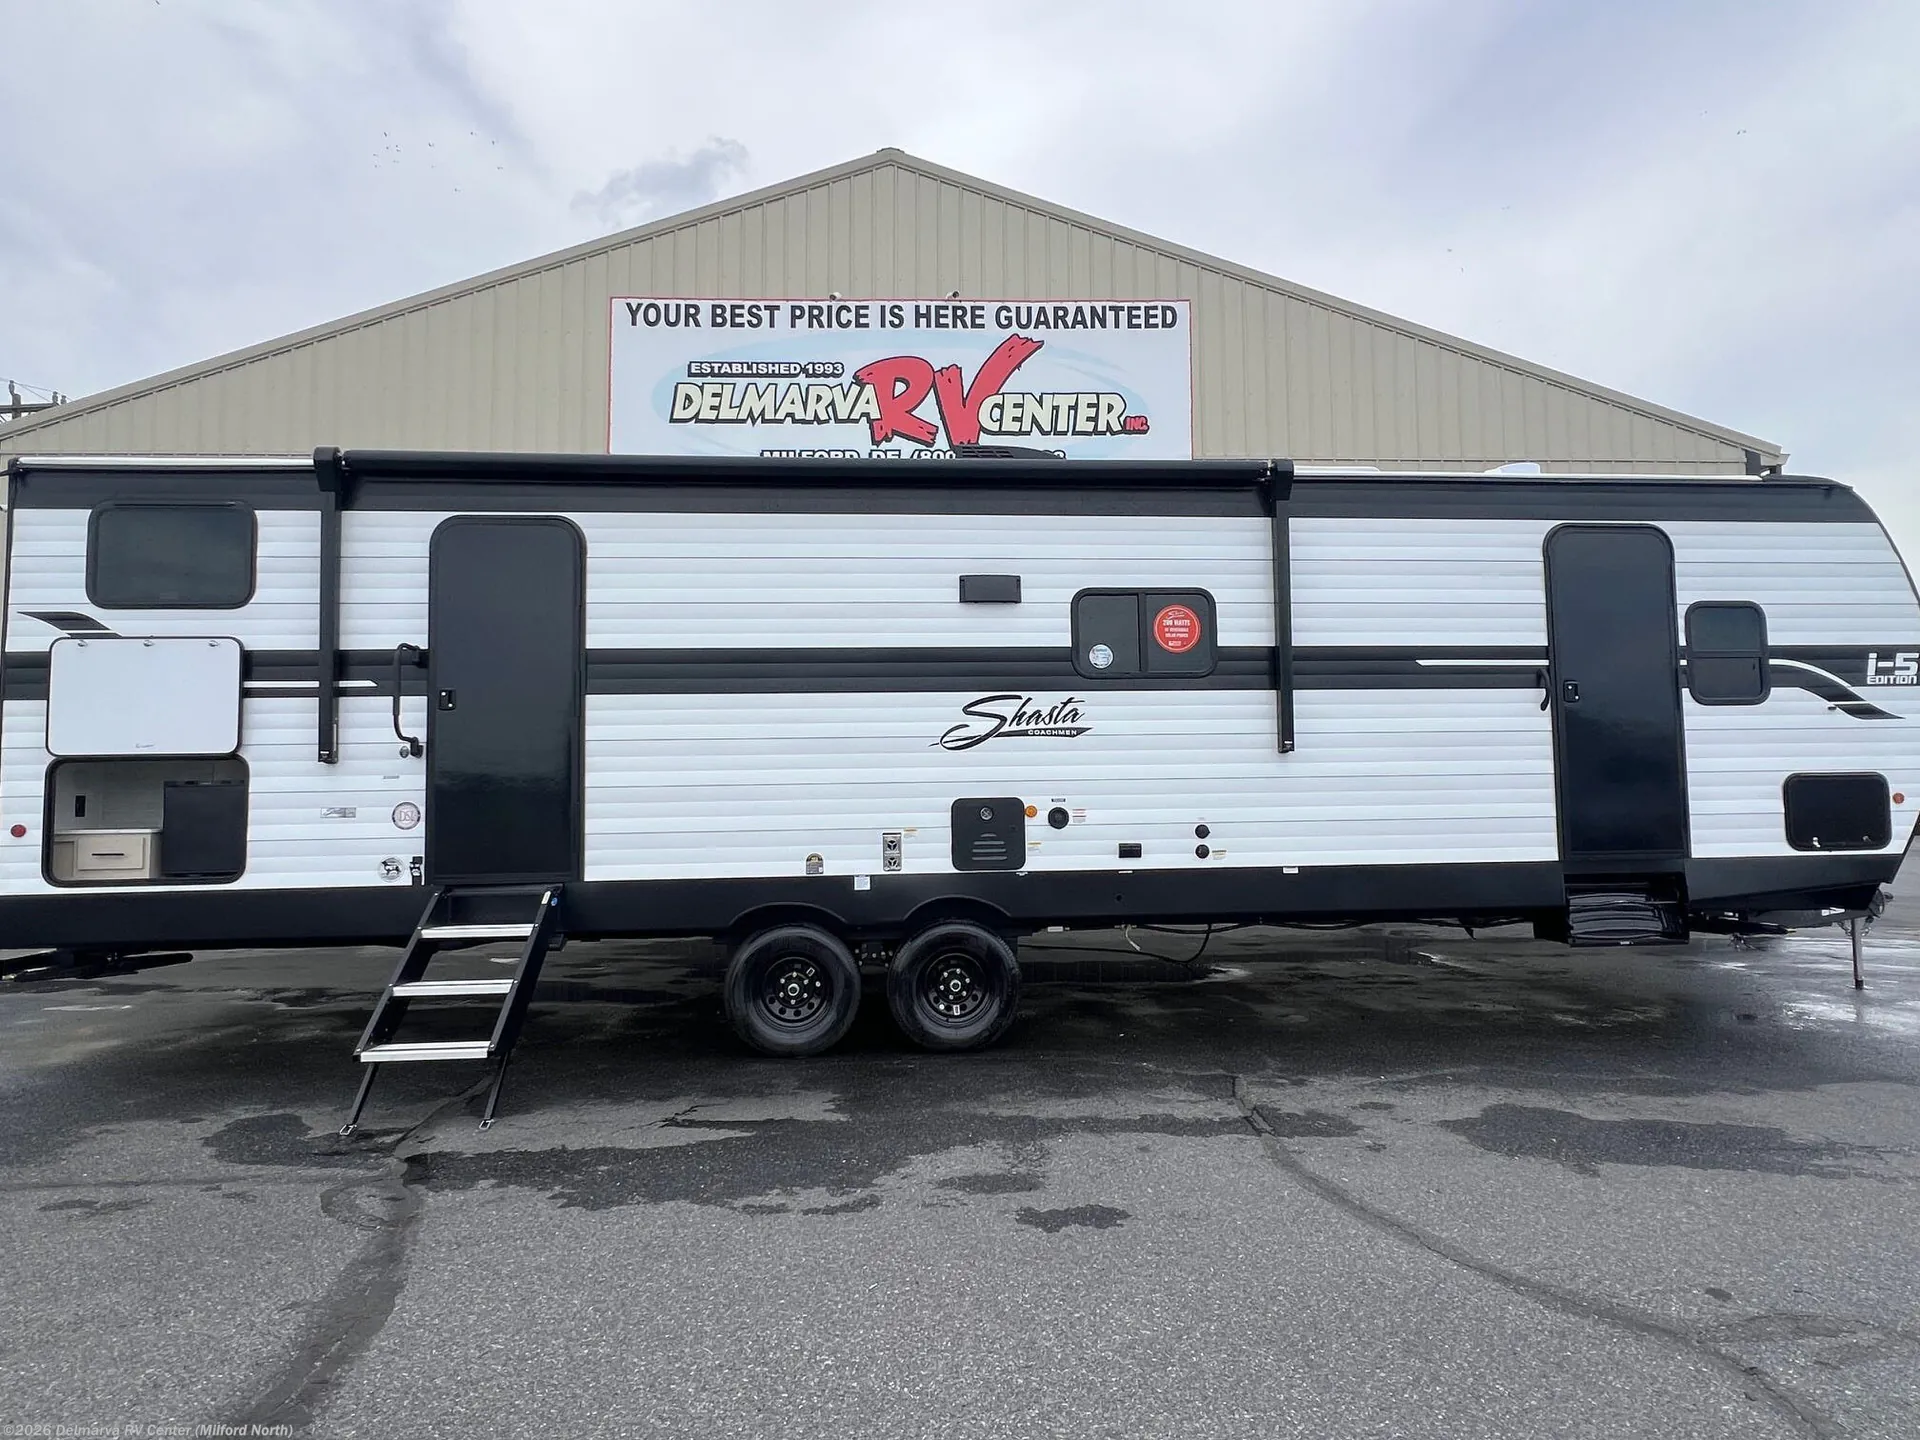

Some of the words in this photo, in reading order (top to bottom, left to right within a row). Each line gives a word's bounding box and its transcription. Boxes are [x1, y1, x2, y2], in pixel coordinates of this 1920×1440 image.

[625, 302, 701, 328] YOUR
[710, 304, 781, 329] BEST
[789, 304, 870, 329] PRICE
[879, 304, 905, 328] IS
[913, 305, 986, 329] HERE
[994, 305, 1178, 330] GUARANTEED
[688, 361, 801, 377] ESTABLISHED
[803, 363, 845, 375] 1993
[669, 382, 883, 426] DELMARVA
[853, 333, 1045, 446] RV
[976, 392, 1126, 436] CENTER
[1867, 652, 1920, 676] i-5
[1867, 675, 1918, 685] EDITION
[928, 694, 1086, 751] Shasta
